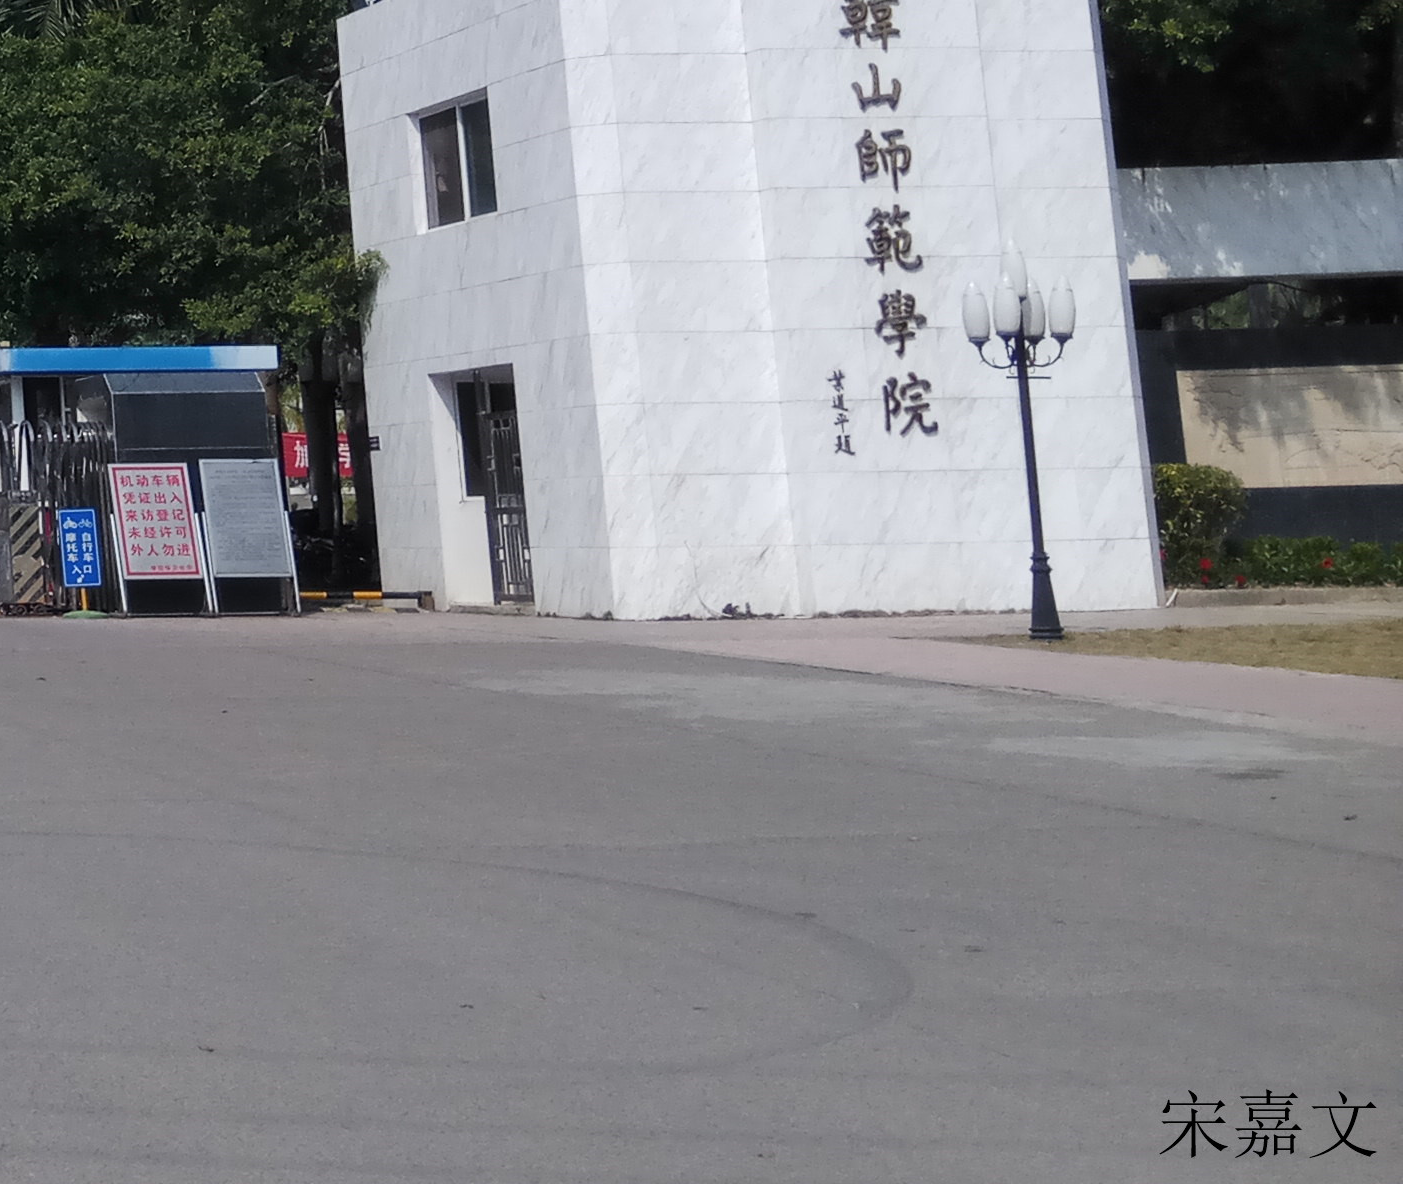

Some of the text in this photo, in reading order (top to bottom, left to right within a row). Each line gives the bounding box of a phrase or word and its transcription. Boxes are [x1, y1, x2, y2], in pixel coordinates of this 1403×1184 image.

[120, 475, 180, 487] 机动车辆
[123, 492, 183, 504] 凭证出入
[126, 509, 186, 521] 来访登记
[129, 526, 187, 539] 未经许可
[131, 543, 191, 556] 外人勿进
[72, 564, 92, 574] 入口
